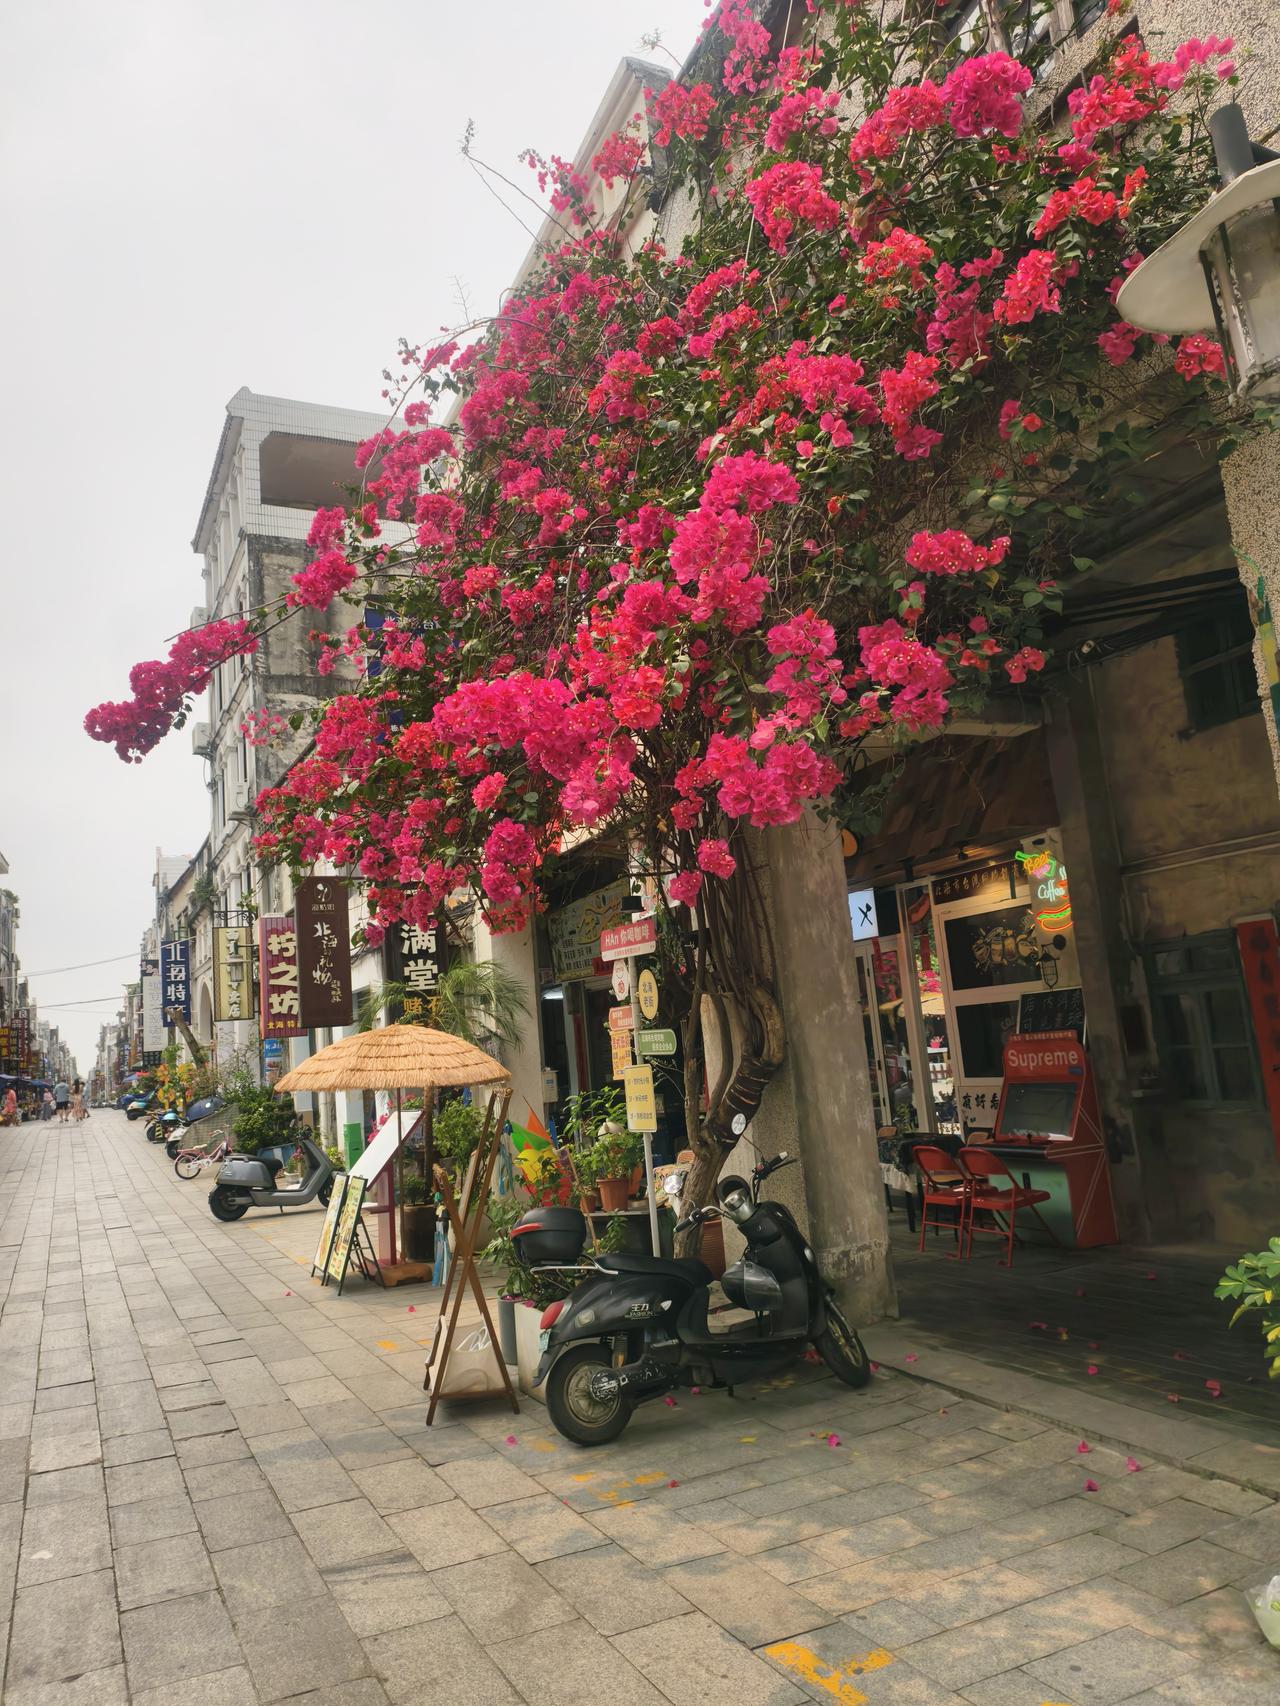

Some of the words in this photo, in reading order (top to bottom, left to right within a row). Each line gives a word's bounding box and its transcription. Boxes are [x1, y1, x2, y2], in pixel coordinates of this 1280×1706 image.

[620, 924, 650, 945] 你喝咖啡
[1007, 1049, 1079, 1071] Supreme
